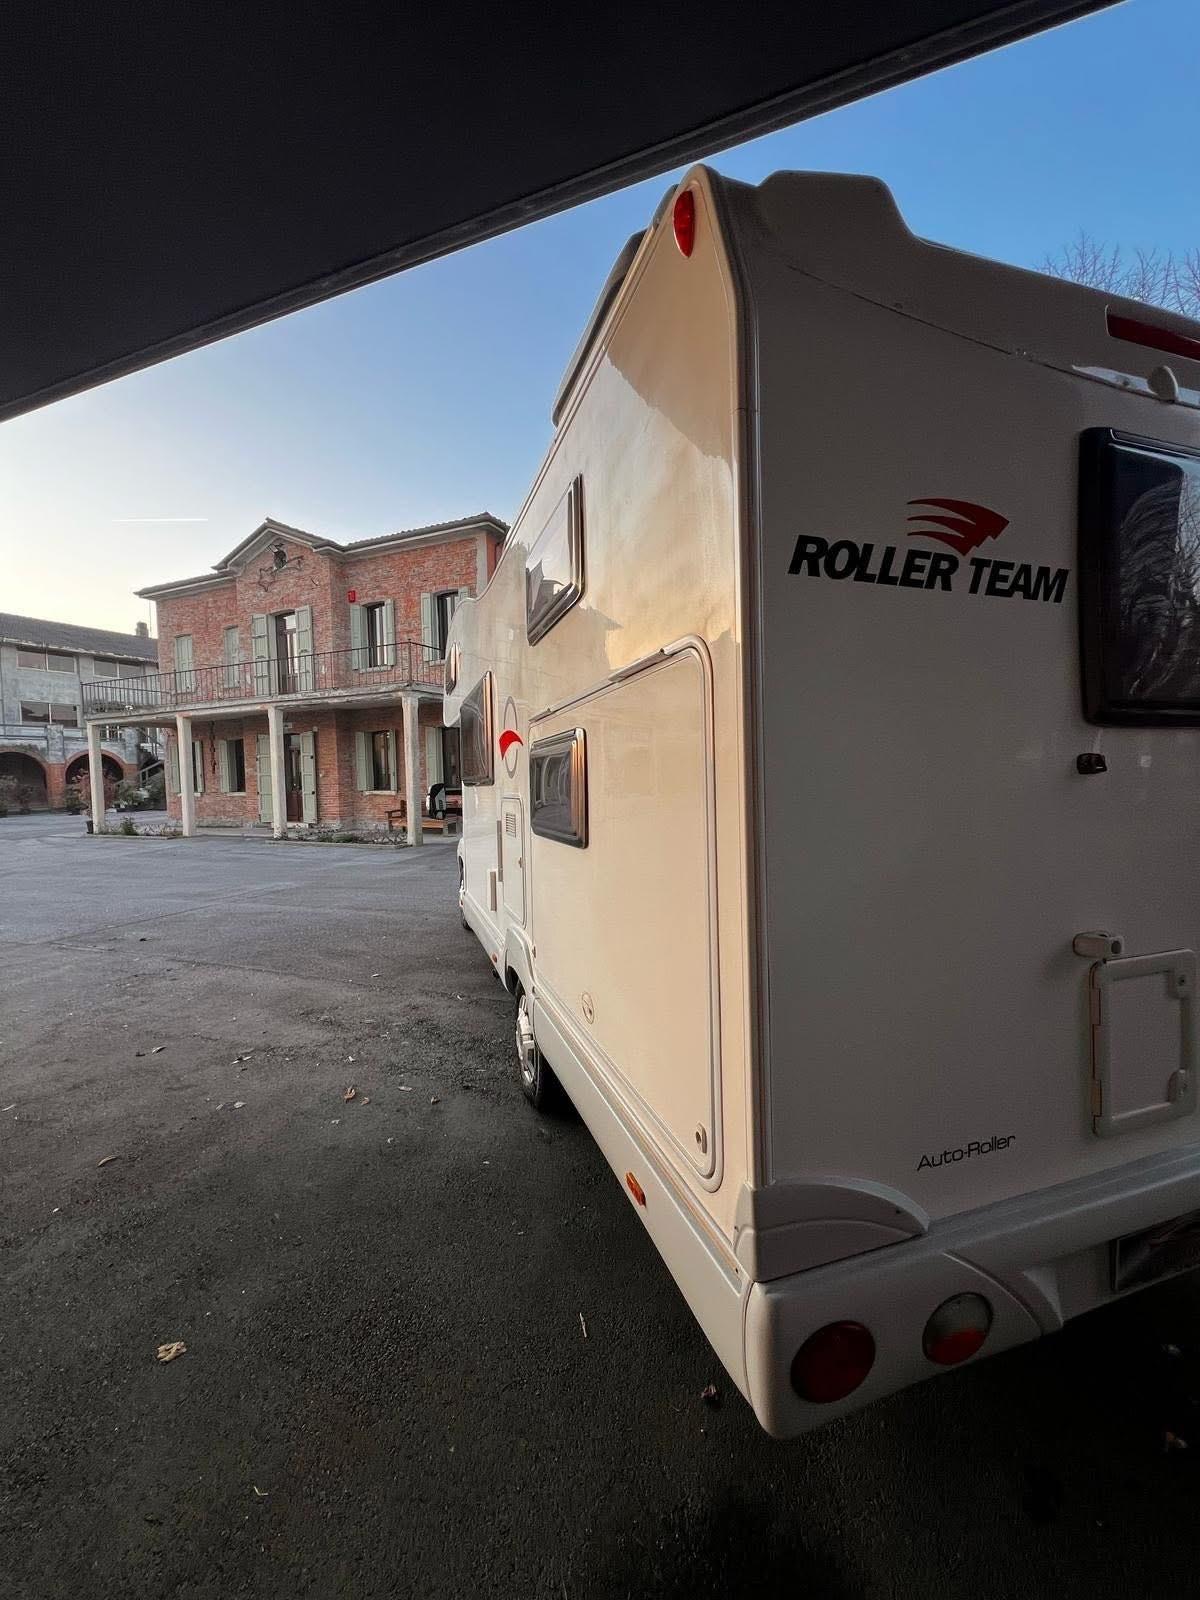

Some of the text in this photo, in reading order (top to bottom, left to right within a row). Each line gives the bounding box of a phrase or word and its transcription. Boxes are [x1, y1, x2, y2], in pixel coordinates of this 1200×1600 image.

[787, 534, 1070, 604] ROLLER TEAM
[916, 1135, 1016, 1172] Auto-Roller
